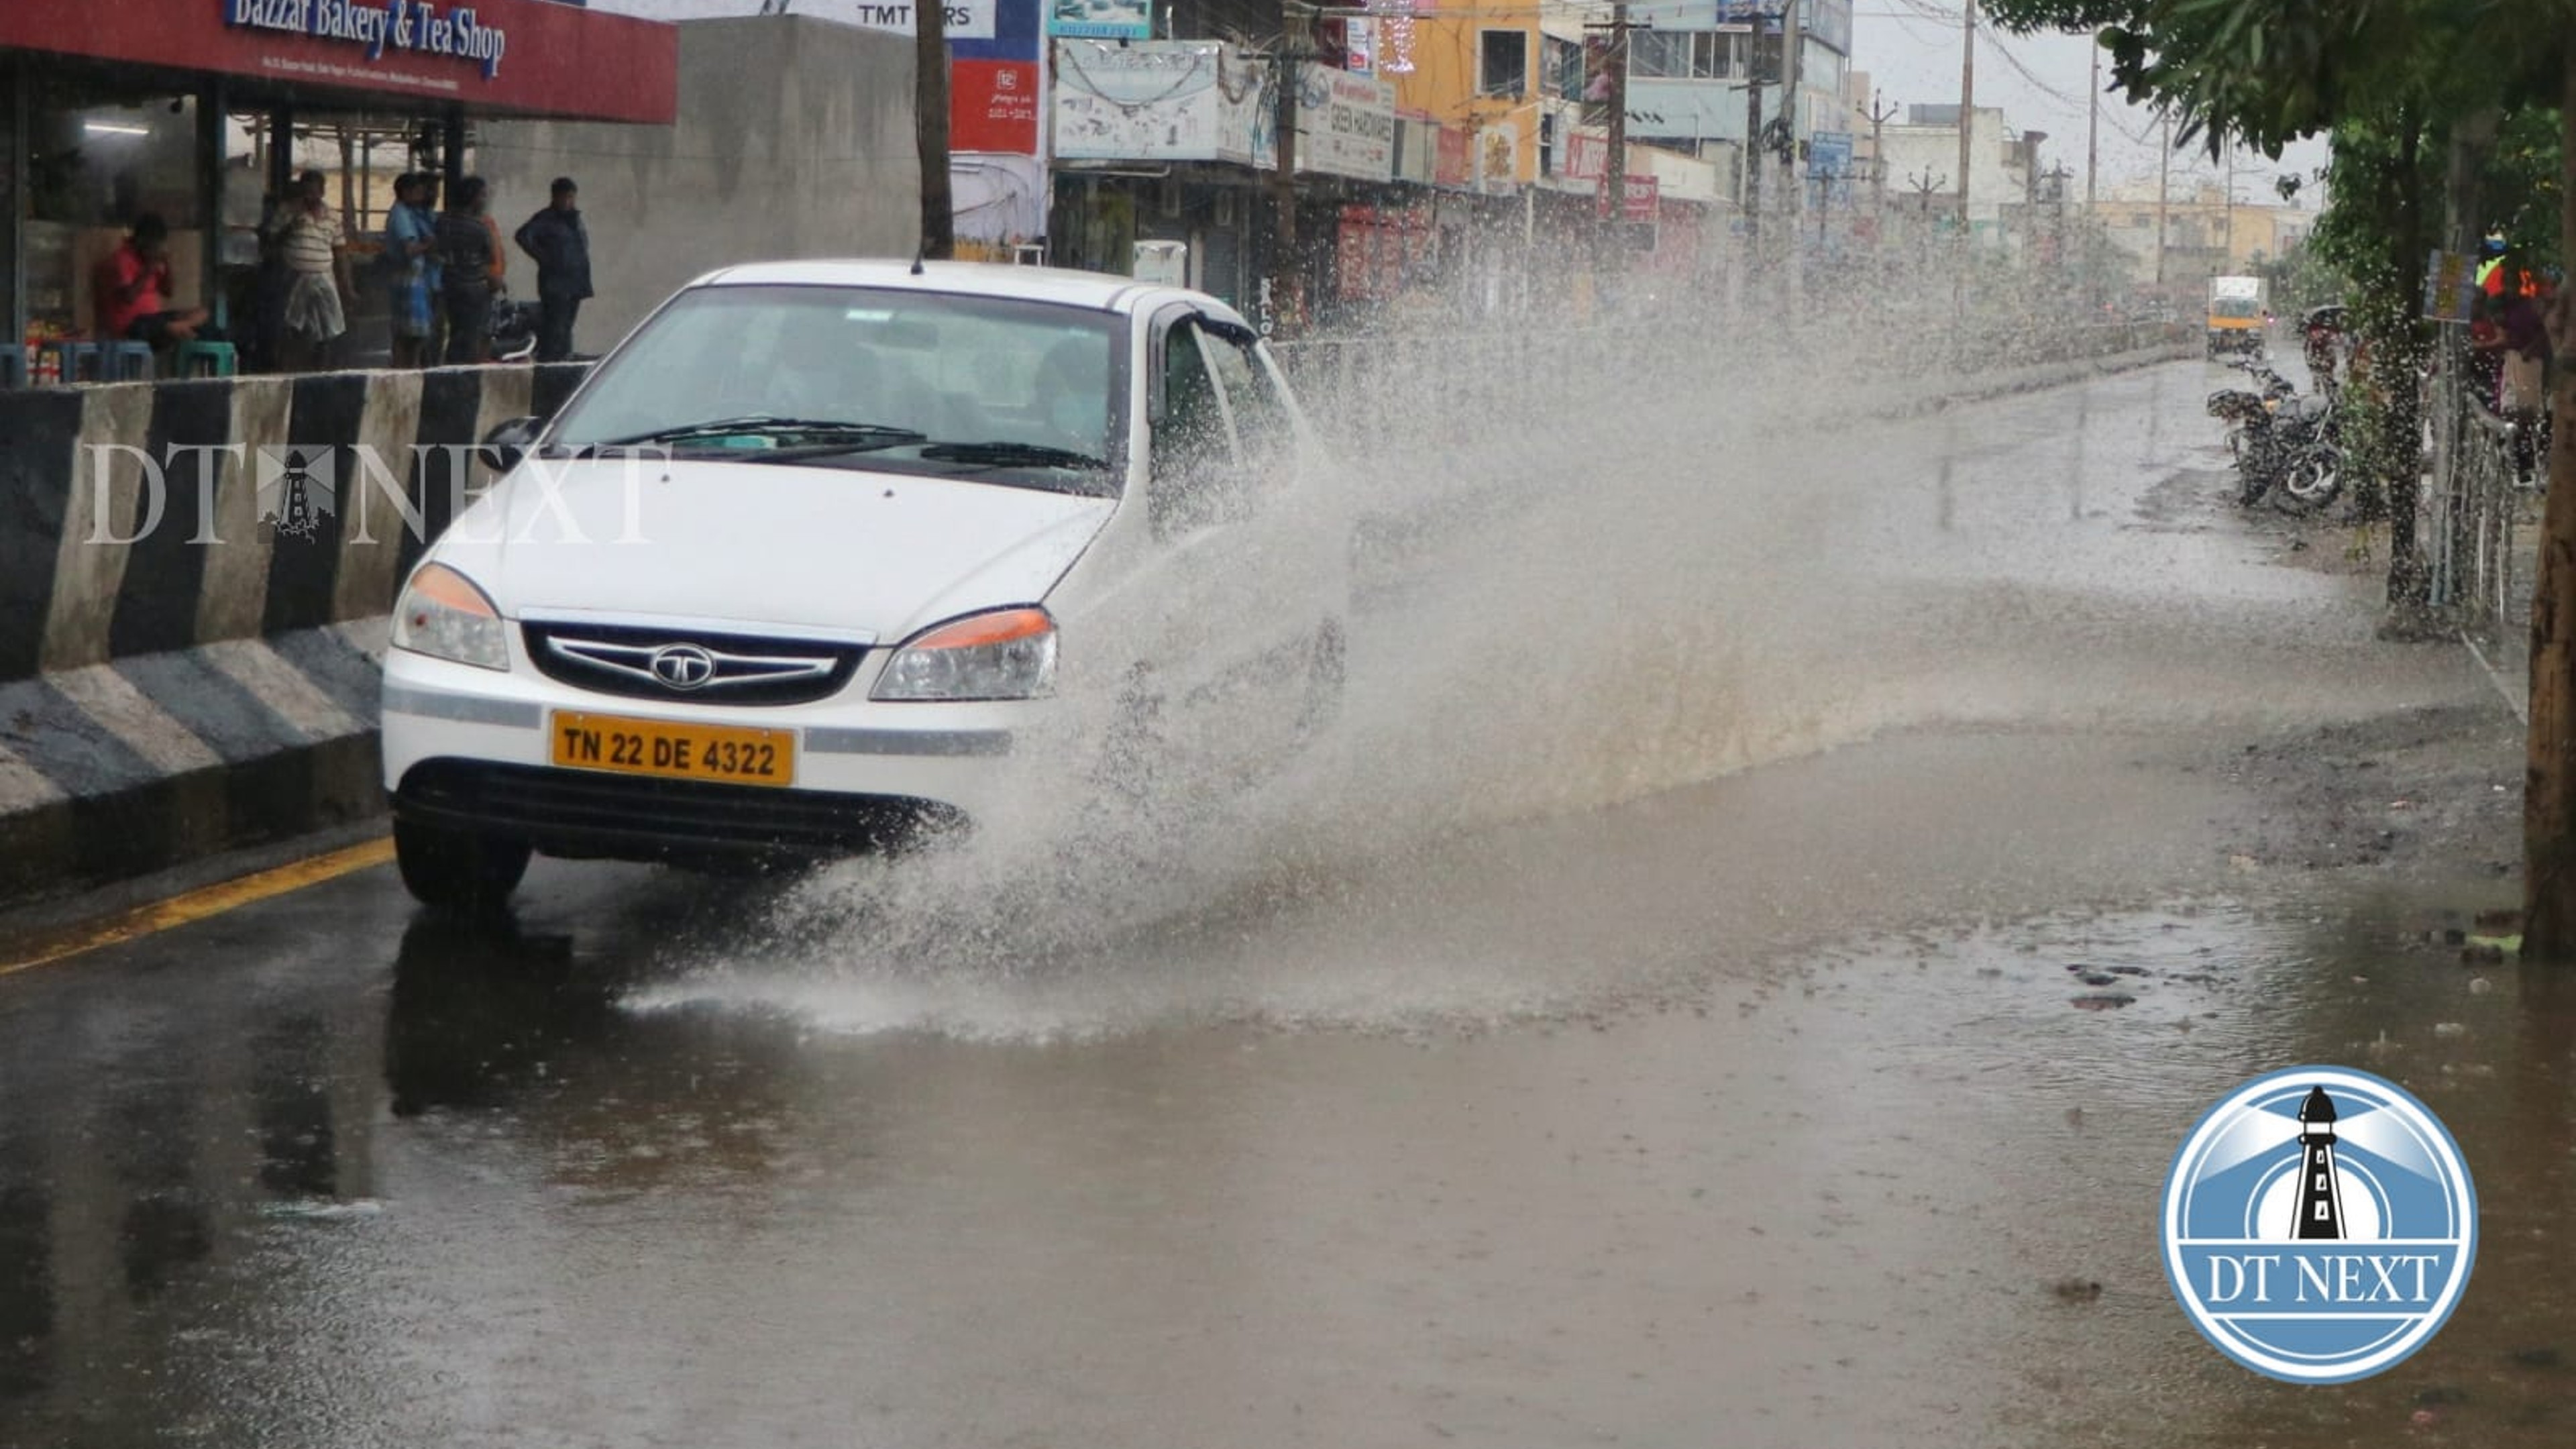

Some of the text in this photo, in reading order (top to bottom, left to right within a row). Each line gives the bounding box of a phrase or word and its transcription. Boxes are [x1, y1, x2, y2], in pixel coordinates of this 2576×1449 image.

[317, 0, 389, 60] Bakery
[394, 0, 413, 48] &
[417, 1, 453, 54] Tea
[456, 8, 505, 77] Shop
[857, 5, 971, 25] TMT RS
[564, 729, 775, 776] TN 22 DE 4322
